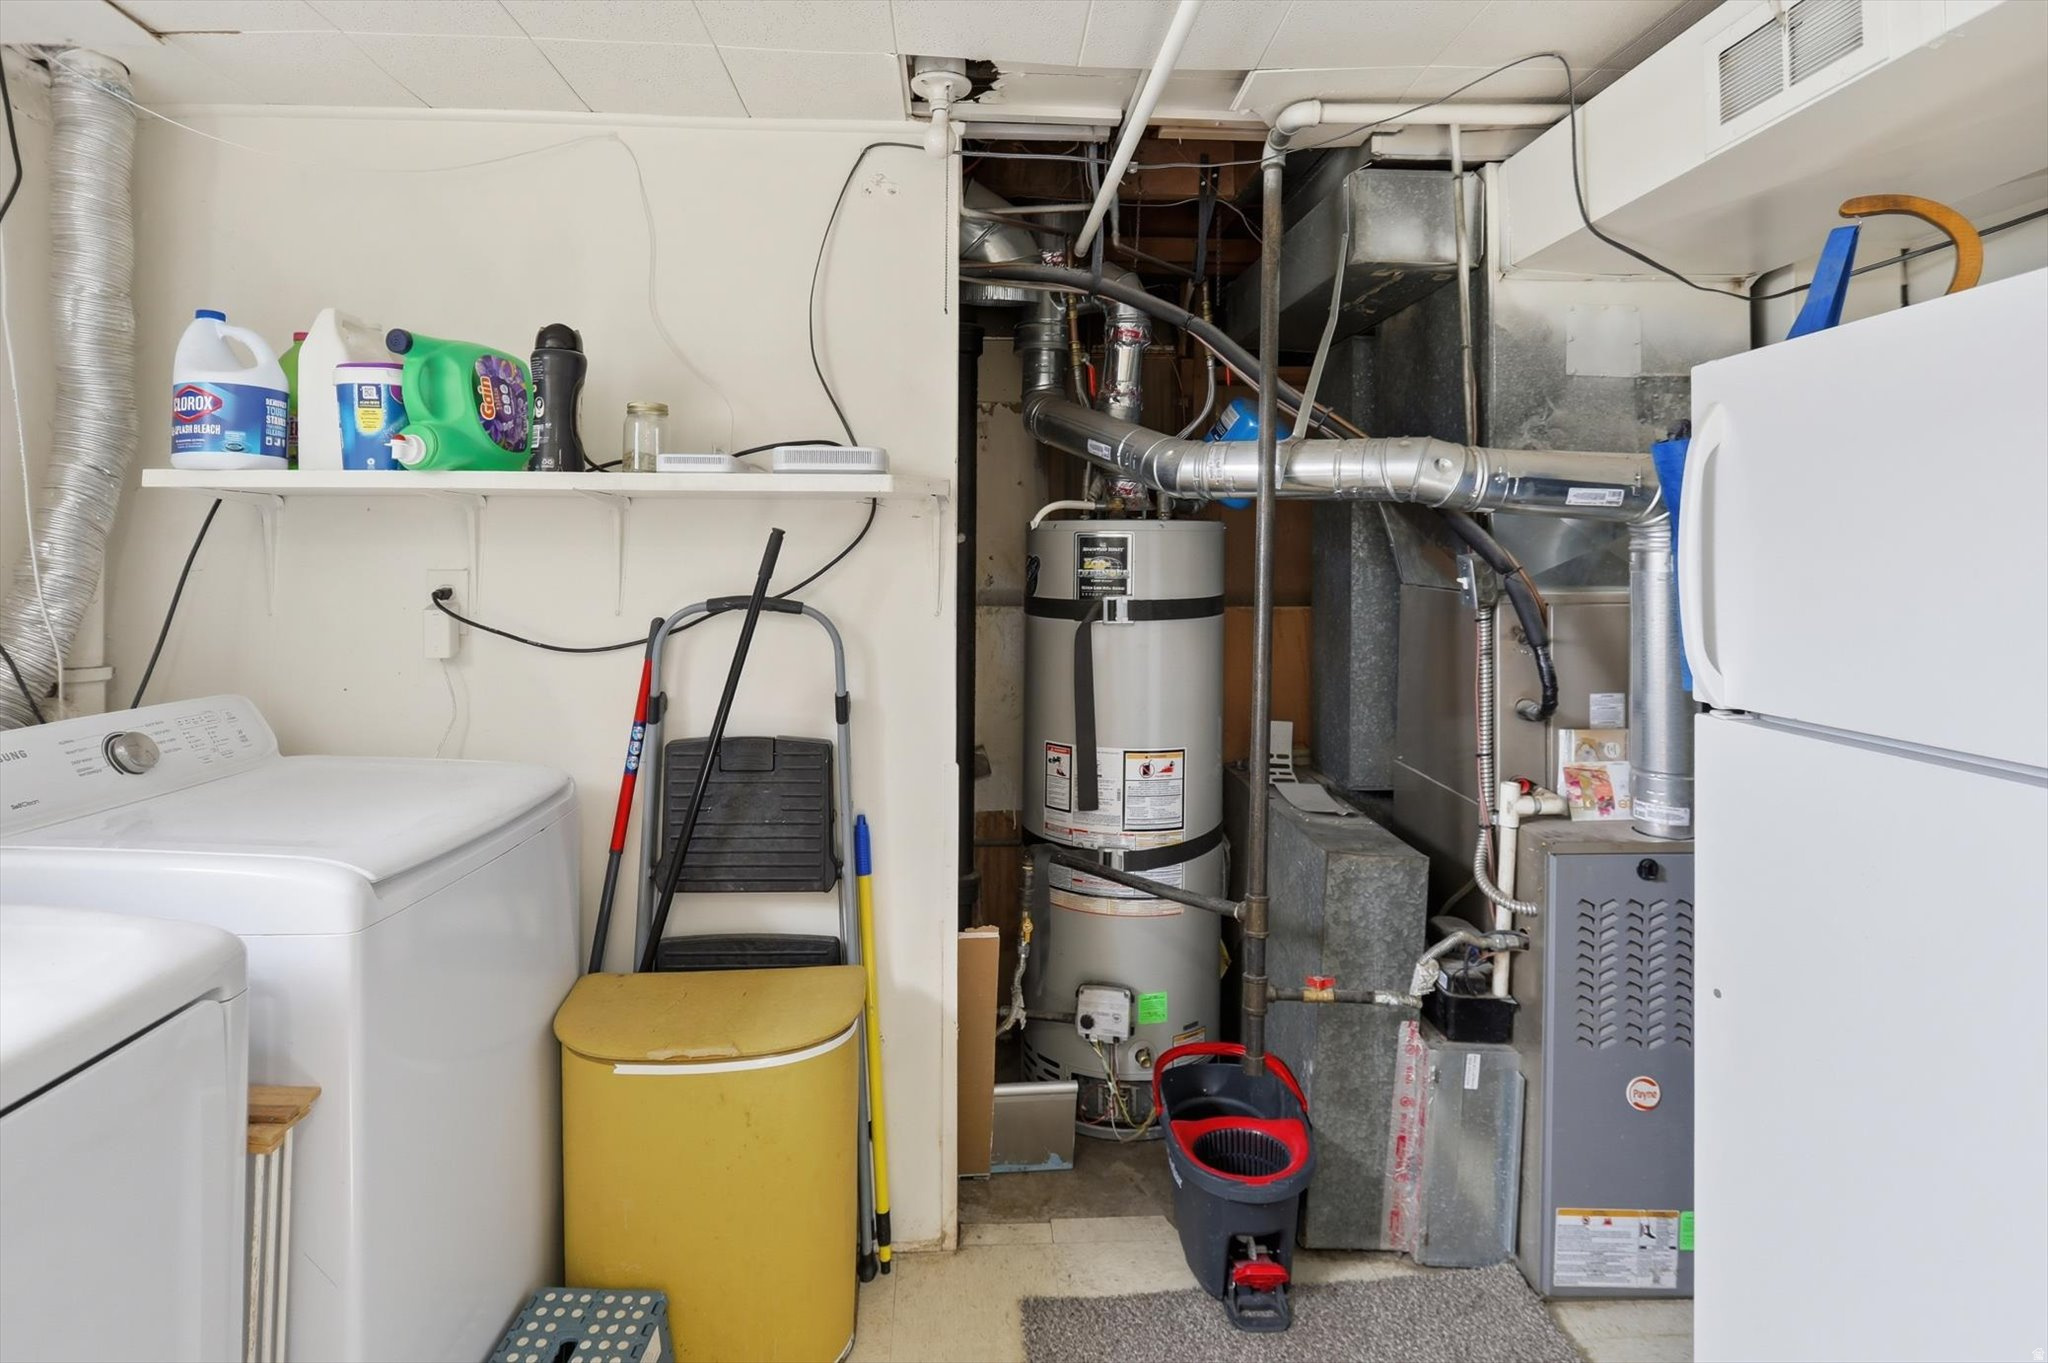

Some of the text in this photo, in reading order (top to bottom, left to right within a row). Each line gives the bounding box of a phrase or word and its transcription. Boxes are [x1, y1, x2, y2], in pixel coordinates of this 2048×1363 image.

[173, 395, 213, 412] CLOROX
[477, 376, 496, 420] Gain
[193, 424, 221, 435] BLEACH
